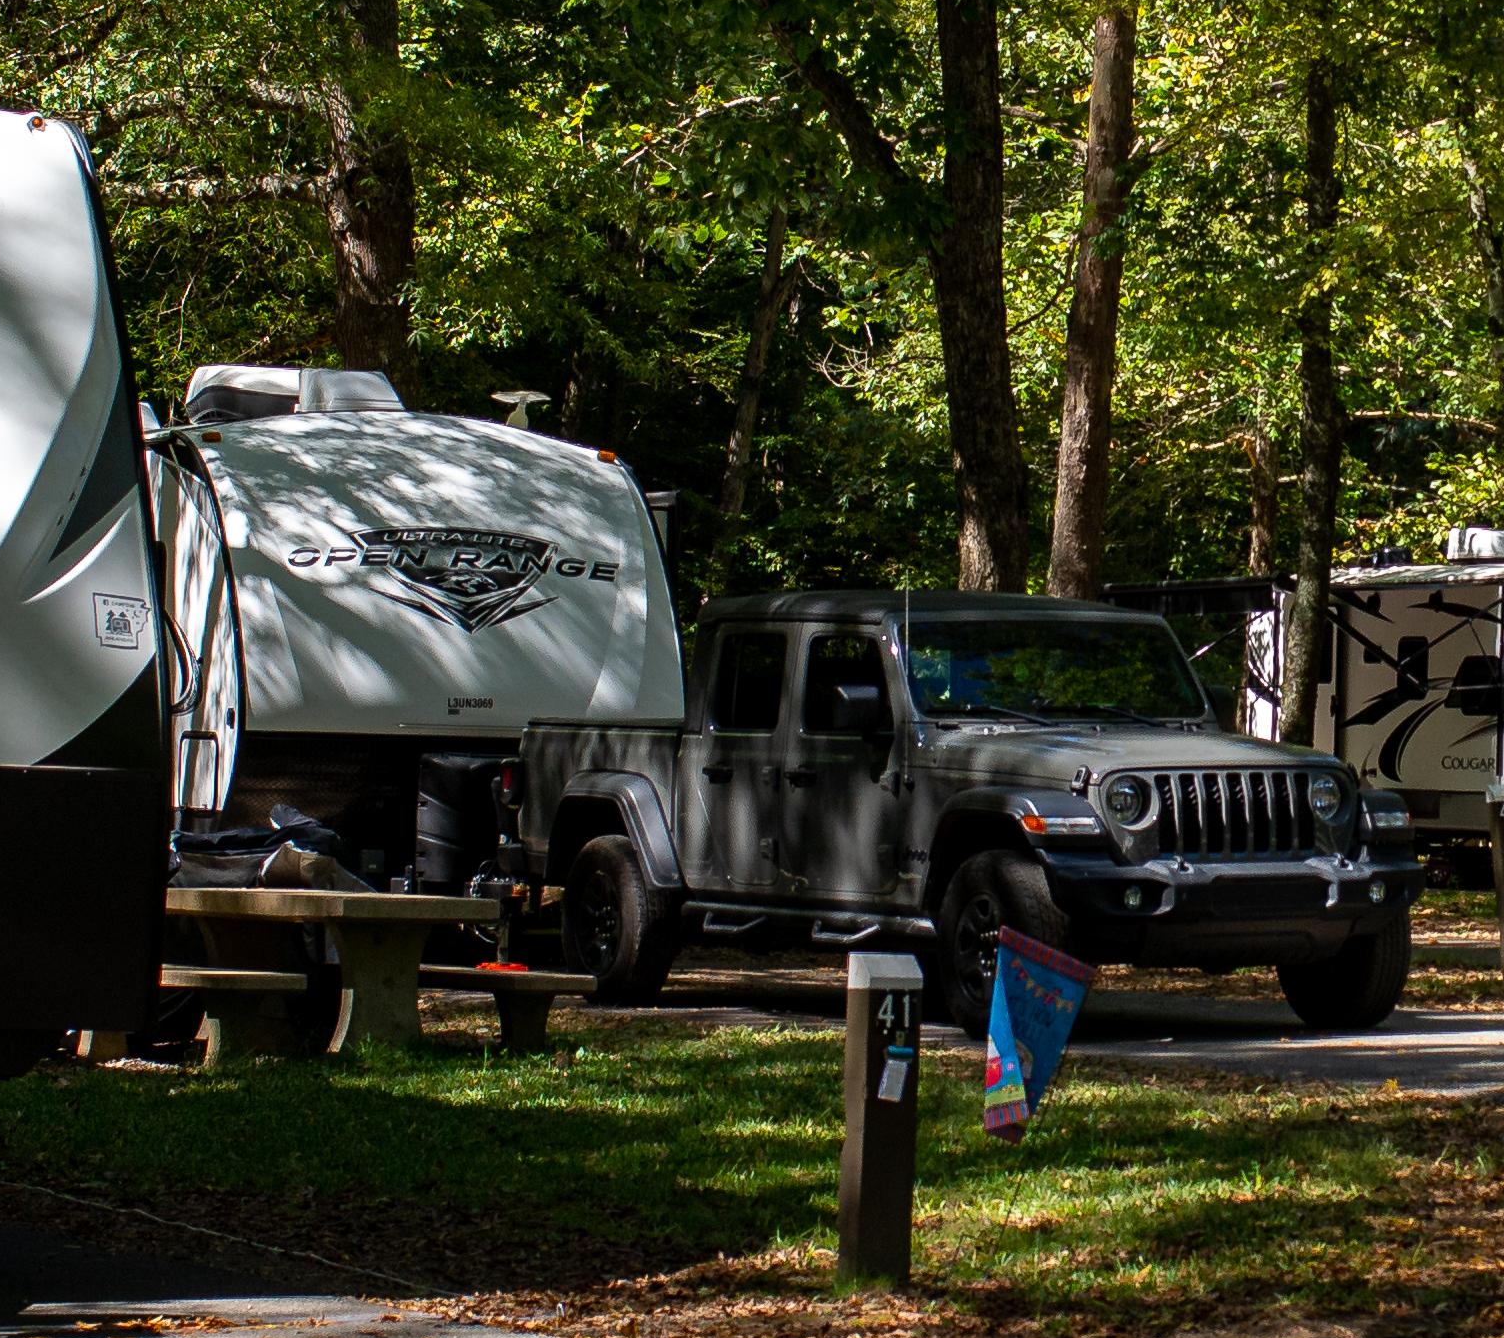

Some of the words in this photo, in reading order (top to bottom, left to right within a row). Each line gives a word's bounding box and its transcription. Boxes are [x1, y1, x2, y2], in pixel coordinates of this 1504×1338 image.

[383, 531, 463, 542] ULTRA
[473, 533, 526, 548] LITE
[287, 545, 430, 568] OPEN
[449, 546, 621, 582] RANGE
[447, 697, 494, 709] L3UN3069
[1441, 755, 1496, 772] COUGAR
[878, 993, 911, 1028] 41
